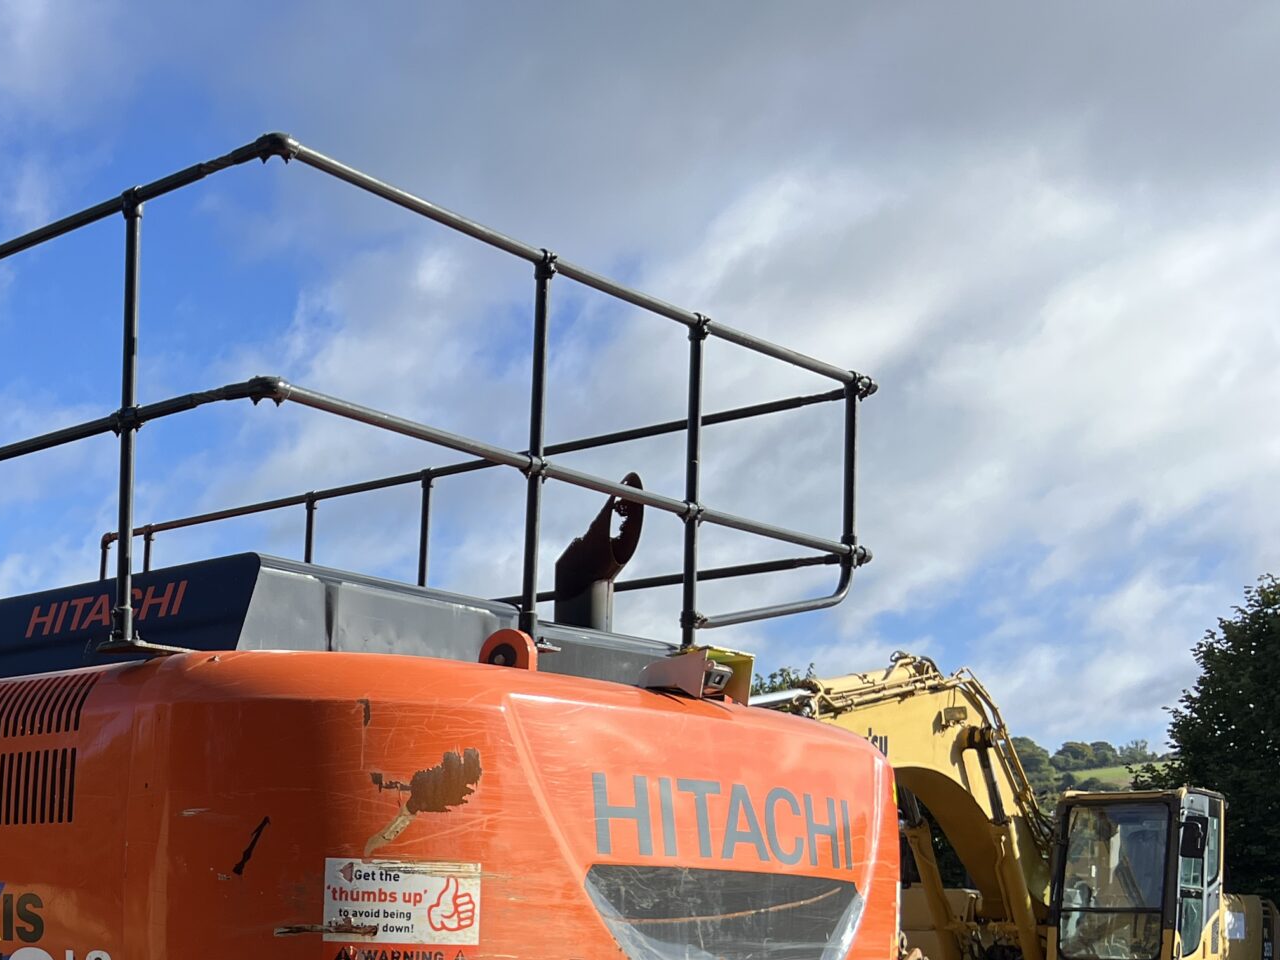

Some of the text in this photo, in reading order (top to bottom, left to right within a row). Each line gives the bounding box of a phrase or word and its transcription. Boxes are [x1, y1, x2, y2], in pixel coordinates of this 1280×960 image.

[591, 772, 853, 871] HITACHI
[354, 869, 400, 882] Get the
[338, 908, 412, 921] to avoid being
[382, 923, 414, 933] down!
